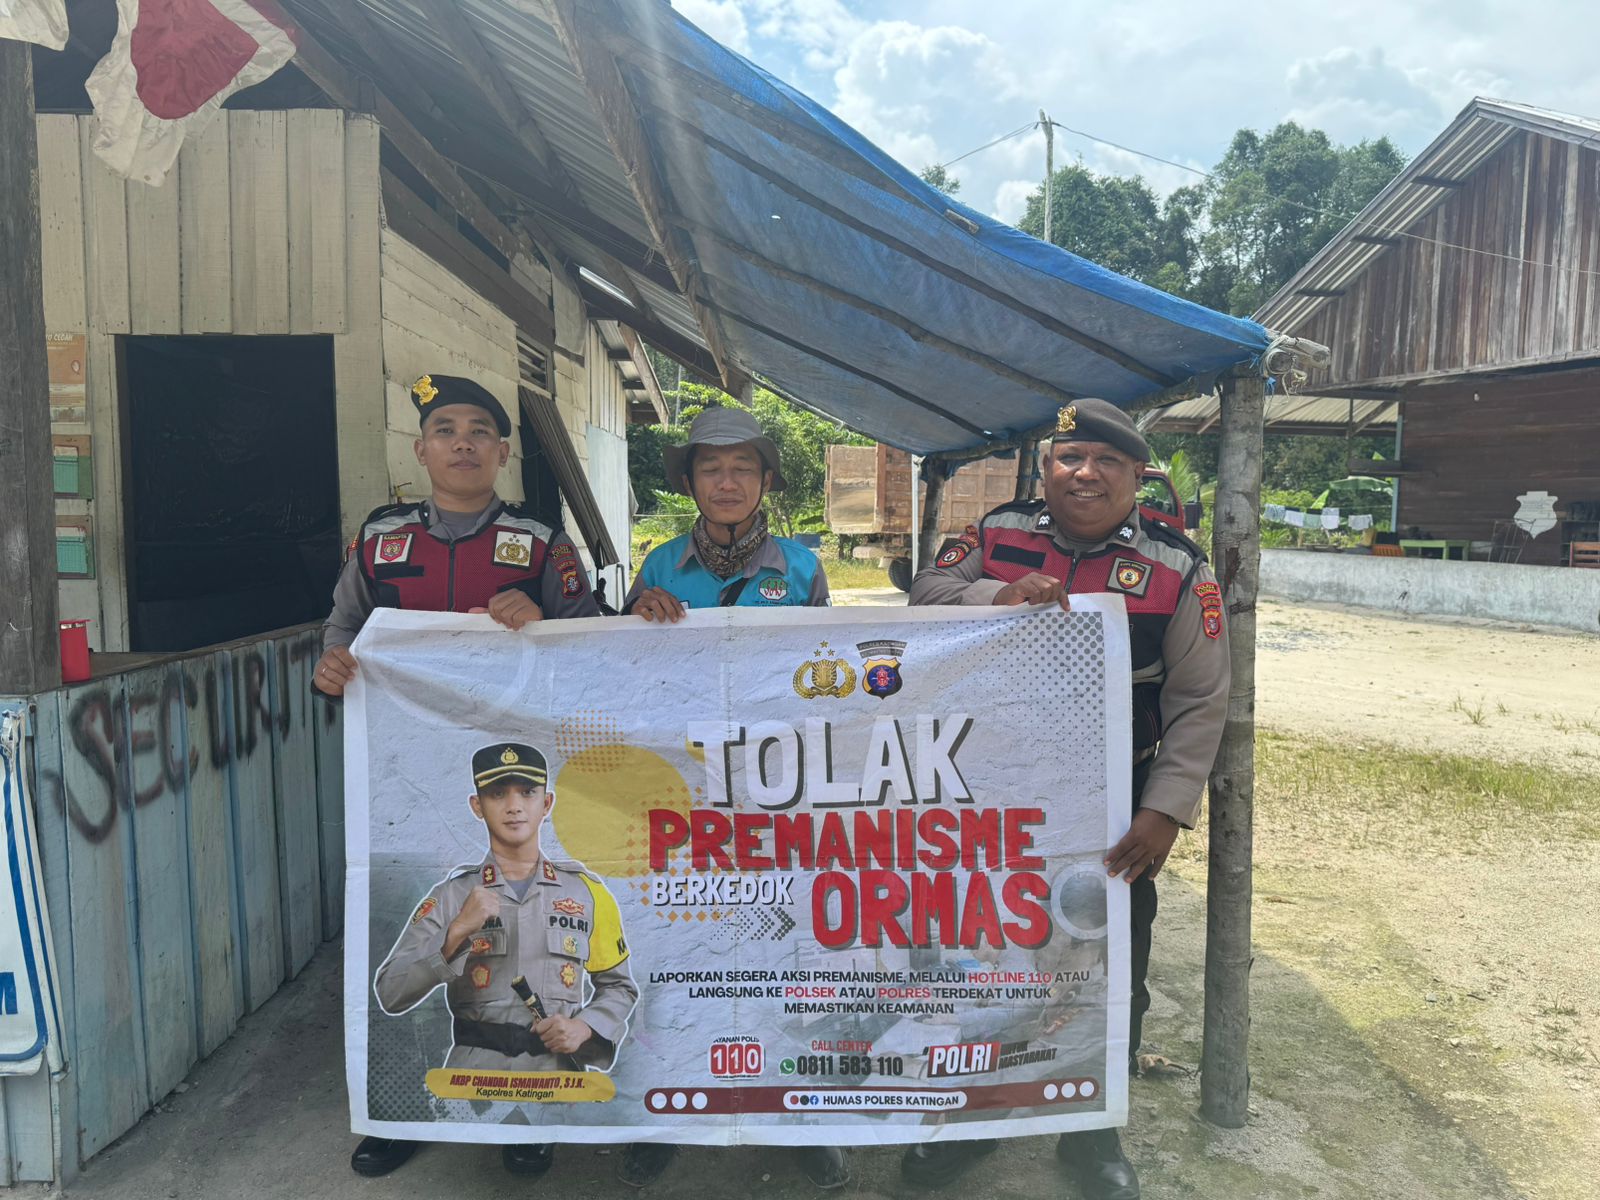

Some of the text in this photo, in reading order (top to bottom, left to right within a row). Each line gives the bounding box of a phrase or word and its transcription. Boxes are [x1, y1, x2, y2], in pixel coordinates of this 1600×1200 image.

[687, 712, 974, 809] TOLAK
[648, 807, 1046, 872] PREMANISME
[652, 870, 1053, 950] BERKEDOK ORMAS
[550, 915, 589, 933] POLRI
[650, 970, 1091, 985] LAPORKAN SEGERA AKSI PREMANISME, MELALUI HOTLINE 110 ATAU
[689, 986, 1052, 999] LANGSUNG KE POLSEK ATAU POLRES TERDEKAT UNTUK
[784, 1002, 954, 1014] MEMASTIKAN KEAMANAN
[811, 1040, 873, 1052] CALL CENTER
[712, 1048, 759, 1071] 110
[797, 1056, 904, 1076] 0811 583 110
[931, 1043, 992, 1075] POLRI
[450, 1074, 471, 1086] AKBP
[472, 1076, 509, 1088] CHANDRA
[476, 1088, 554, 1099] Kapolres Katingan
[823, 1096, 959, 1107] HUMAS POLRES KATINGAN
